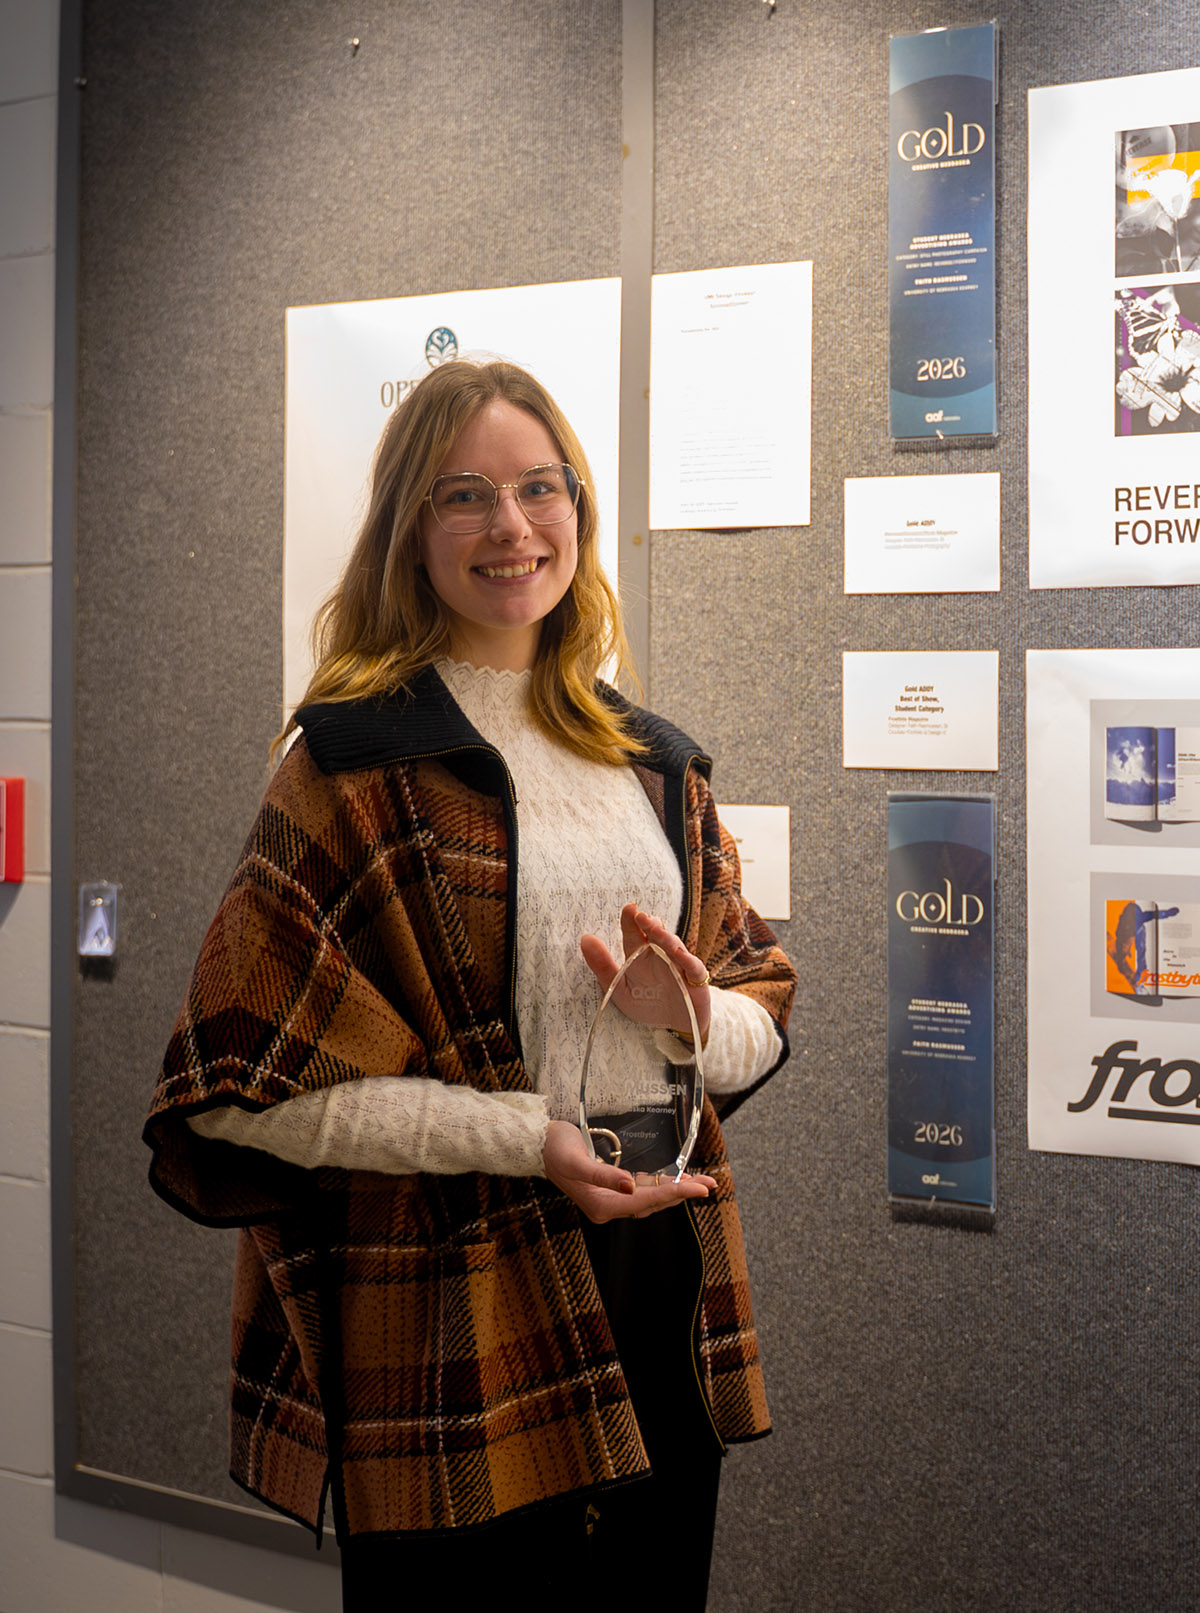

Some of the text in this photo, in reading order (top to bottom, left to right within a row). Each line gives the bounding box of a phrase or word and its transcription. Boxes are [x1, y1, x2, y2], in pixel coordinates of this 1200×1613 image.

[897, 111, 986, 161] GOLD
[917, 357, 967, 381] 2026
[896, 877, 984, 925] GOLD
[914, 1121, 963, 1146] 2026
